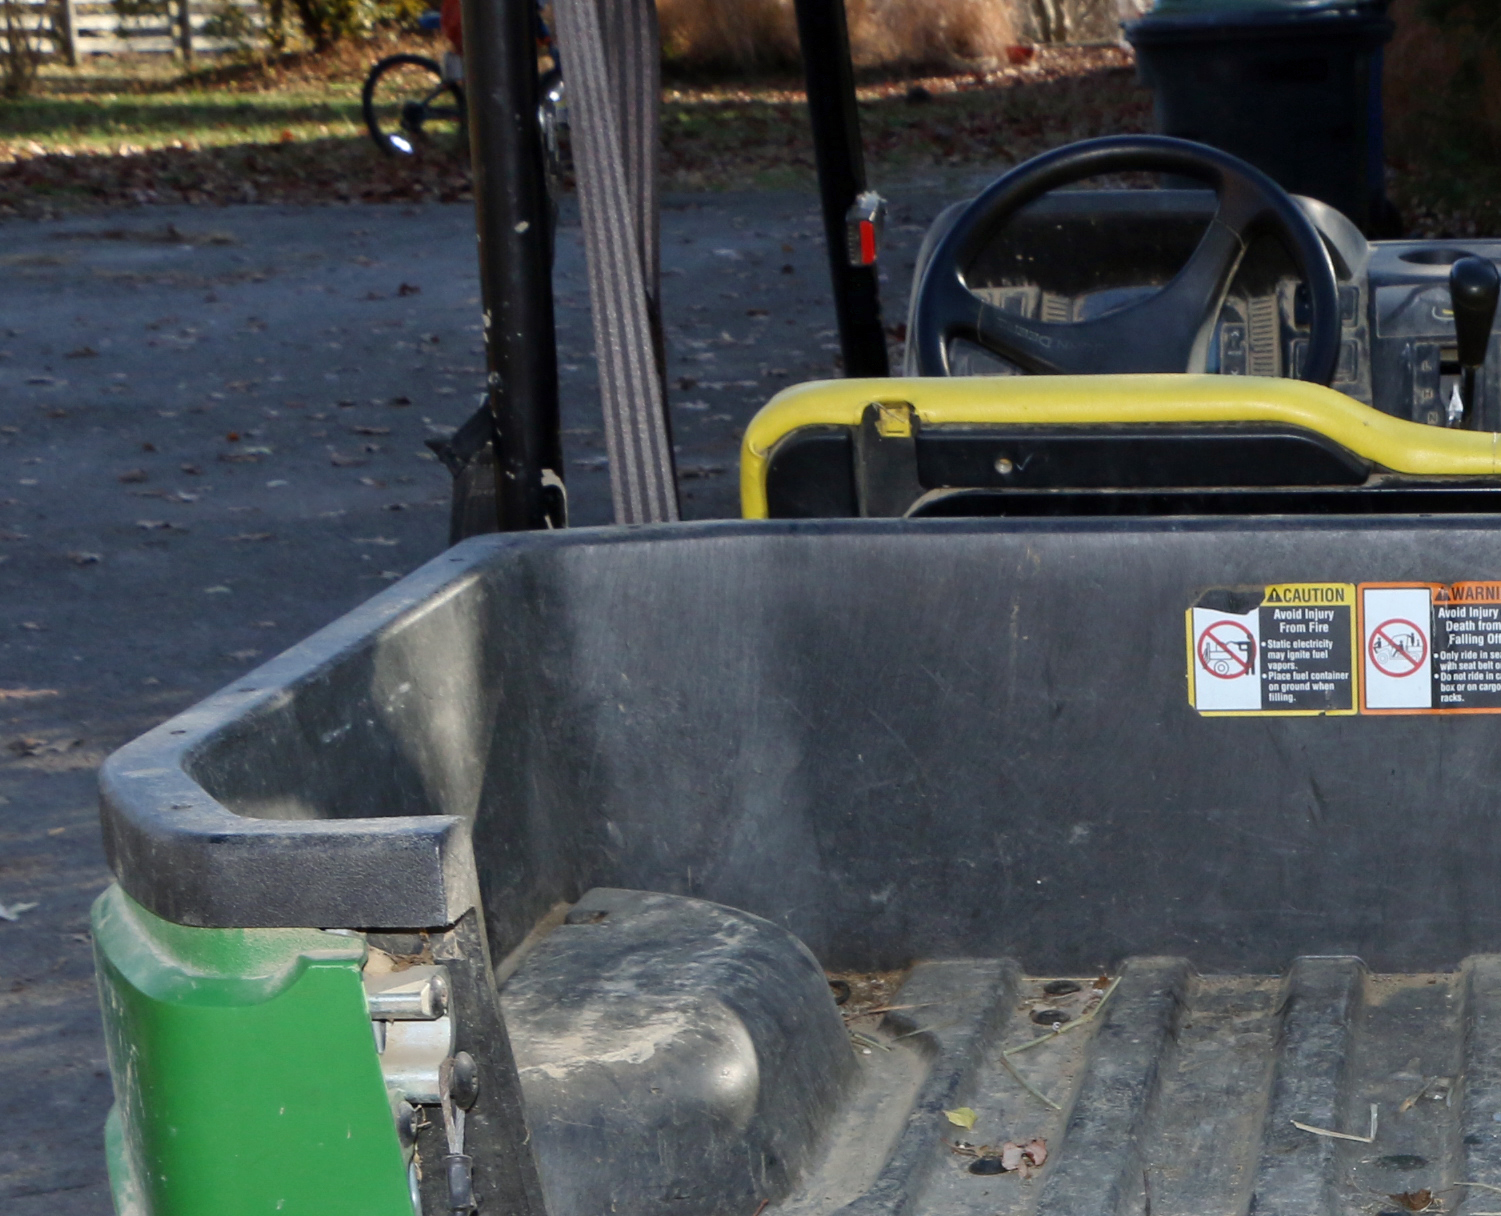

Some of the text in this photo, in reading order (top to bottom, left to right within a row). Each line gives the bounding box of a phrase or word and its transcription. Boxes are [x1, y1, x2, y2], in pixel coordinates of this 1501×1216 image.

[1284, 588, 1344, 602] CAUTION
[1274, 608, 1334, 622] Avoid Injury
[1438, 606, 1466, 618] Avoid
[1469, 606, 1499, 620] Injury
[1280, 622, 1330, 633] From Fire
[1446, 620, 1501, 632] Death from
[1267, 639, 1334, 650] Static electricity
[1449, 632, 1501, 646] Falling Off
[1268, 650, 1328, 661] may ignite fuel
[1440, 650, 1459, 662] Only
[1460, 650, 1478, 660] ride
[1480, 650, 1488, 660] in
[1268, 662, 1298, 672] vapors.
[1458, 661, 1476, 670] seat
[1478, 661, 1494, 670] belt
[1268, 670, 1350, 680] Place fuel container
[1440, 672, 1452, 682] Do
[1453, 672, 1466, 680] not
[1468, 671, 1484, 680] ride
[1486, 671, 1494, 680] in
[1268, 682, 1335, 692] on ground when
[1440, 683, 1456, 692] box
[1456, 684, 1466, 692] or
[1478, 683, 1501, 692] cargo
[1268, 692, 1296, 703] filling.
[1440, 693, 1465, 702] racks.
